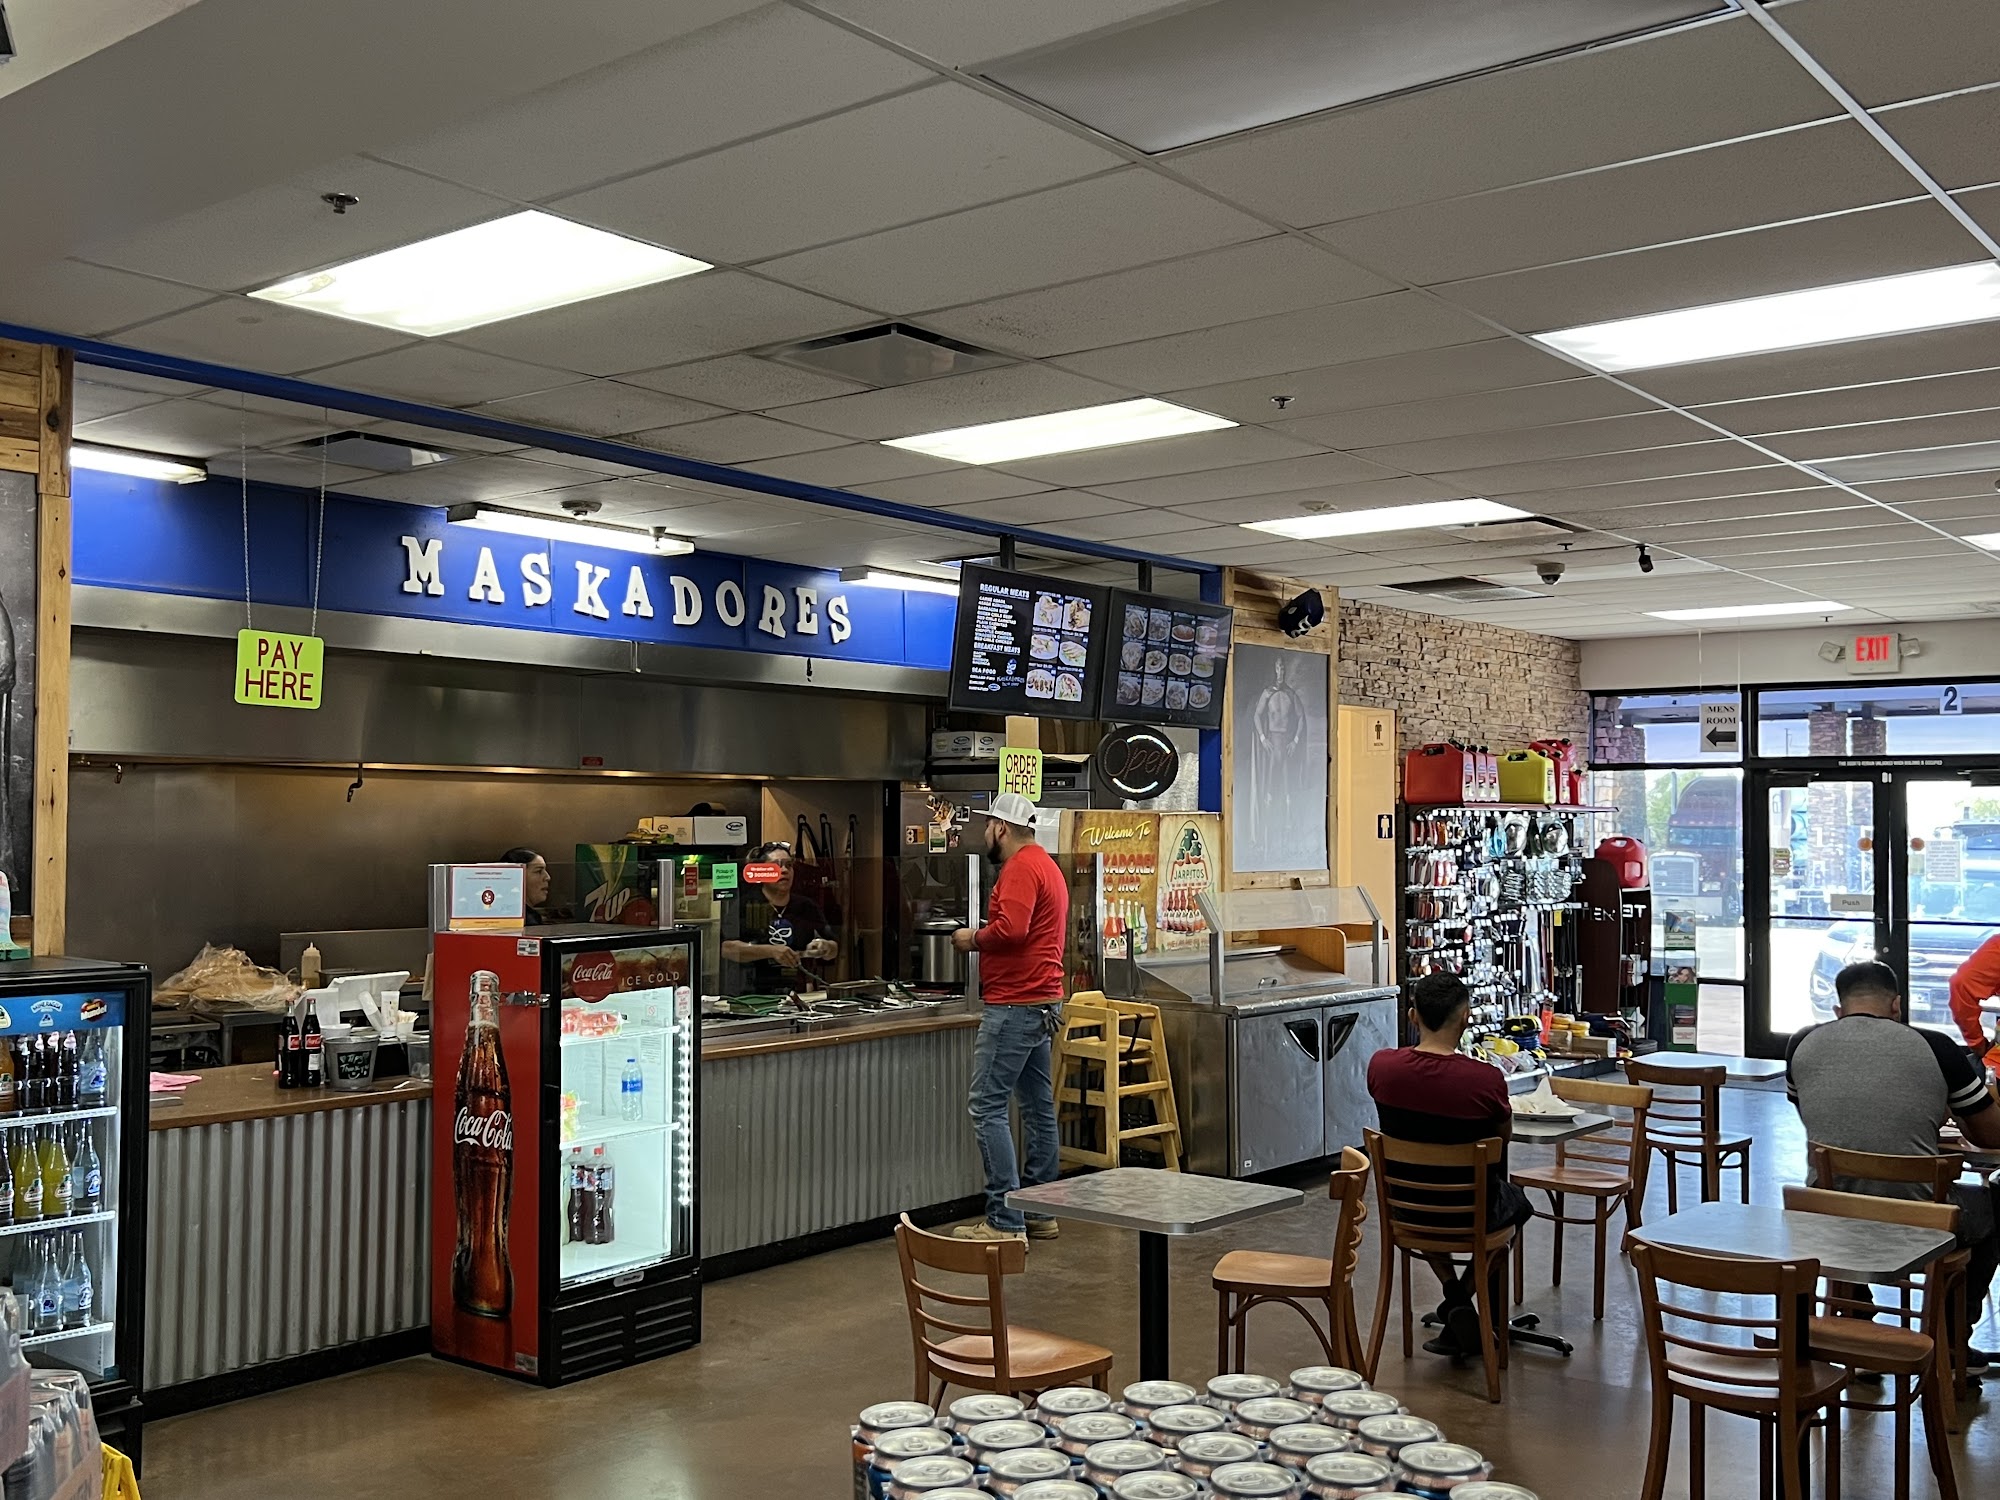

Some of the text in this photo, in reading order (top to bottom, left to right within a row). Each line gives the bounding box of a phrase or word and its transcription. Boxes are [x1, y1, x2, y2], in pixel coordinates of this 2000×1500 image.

[401, 535, 852, 644] MASKADORES
[979, 583, 1009, 595] REGULAR
[1010, 588, 1030, 598] MEATS
[257, 637, 304, 669] PAY
[974, 642, 1021, 654] BREAKFAST MEATS
[1855, 635, 1890, 662] EXIT
[244, 670, 314, 702] HERE
[1943, 686, 1958, 711] 2
[1707, 705, 1735, 713] MENS
[1006, 753, 1037, 774] ORDER
[1104, 738, 1175, 781] Open
[1005, 774, 1036, 794] HERE
[1081, 820, 1151, 846] Welcome To
[621, 971, 680, 986] ICE COLD
[454, 1106, 513, 1151] Coca-Cola
